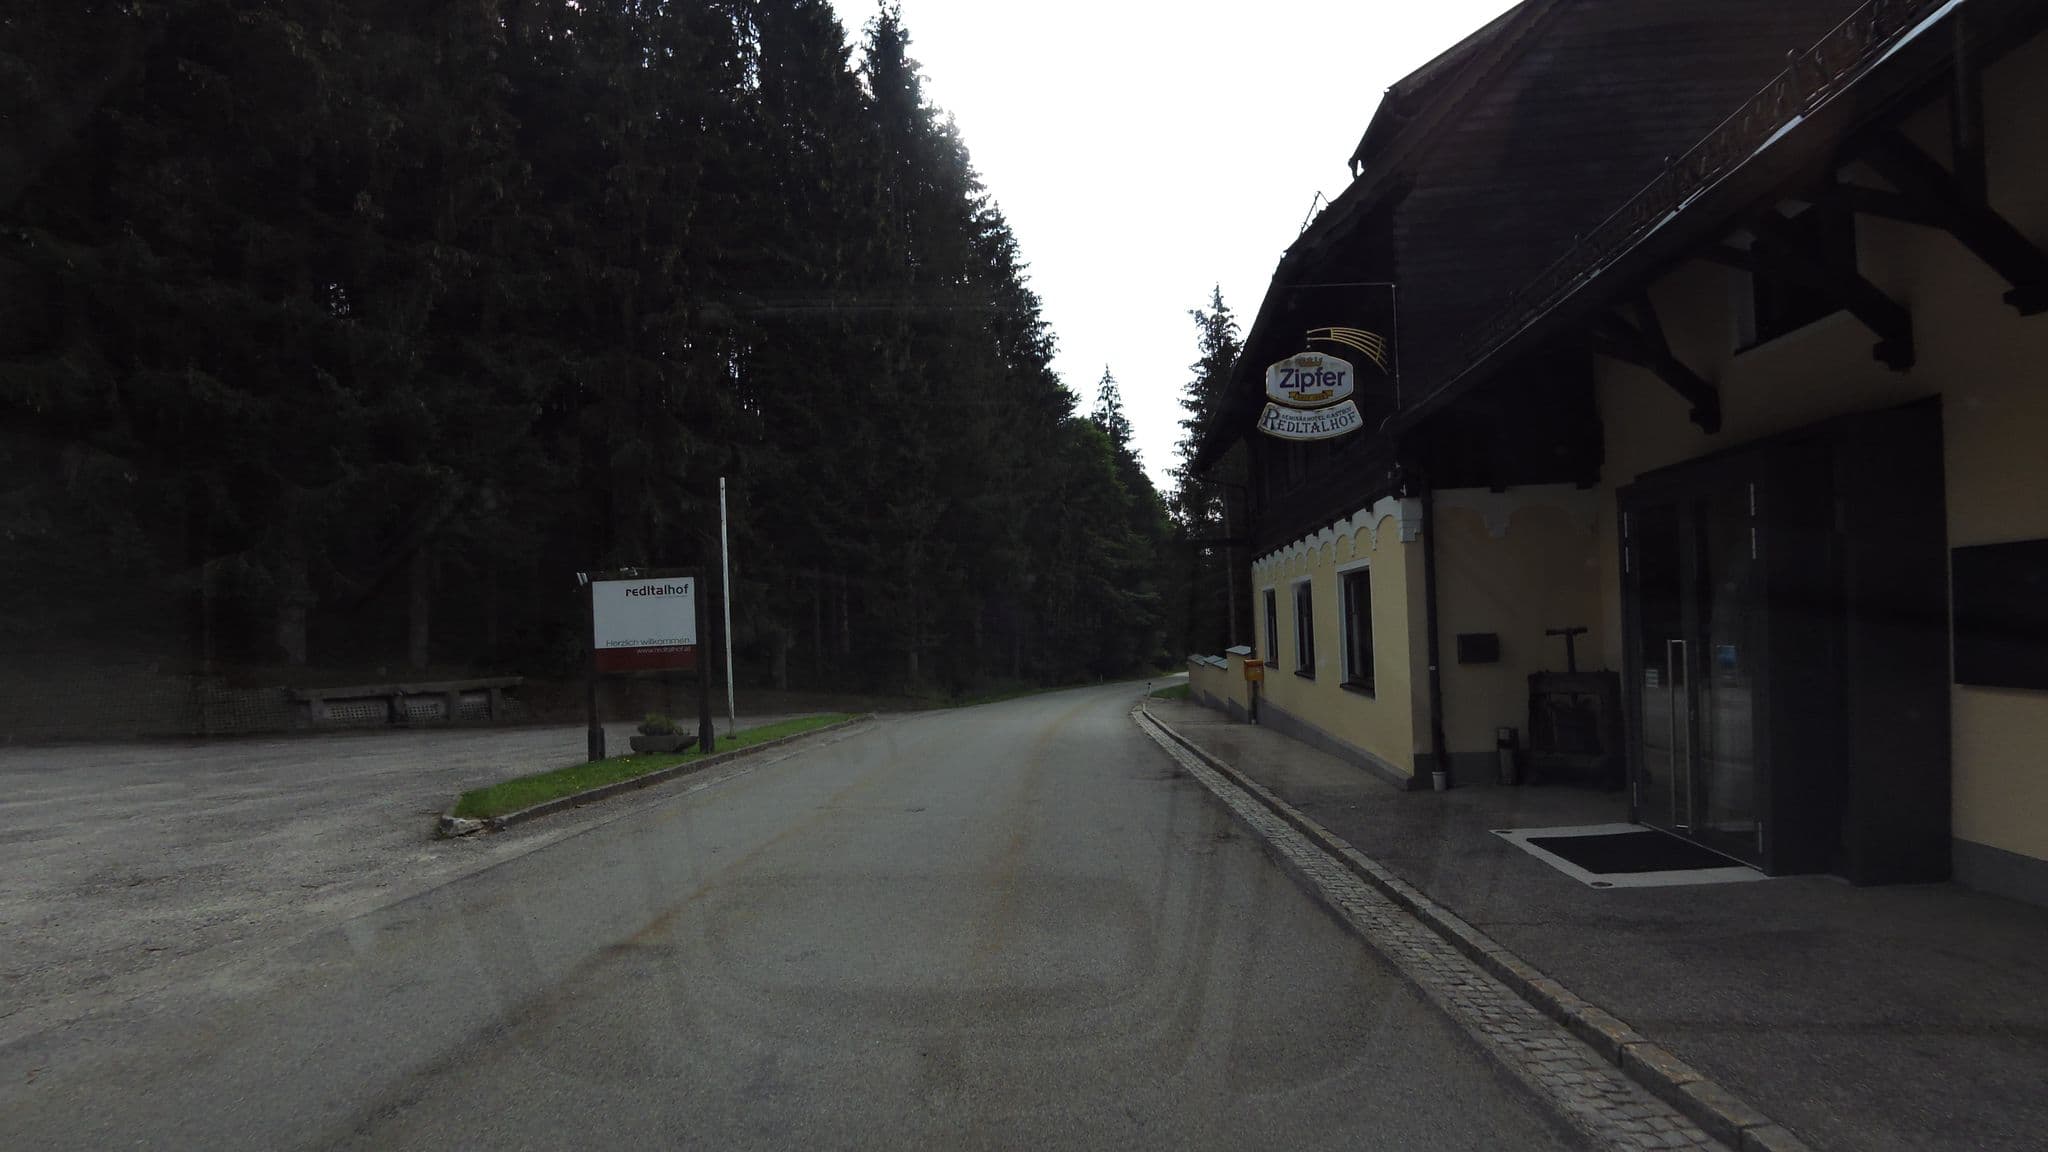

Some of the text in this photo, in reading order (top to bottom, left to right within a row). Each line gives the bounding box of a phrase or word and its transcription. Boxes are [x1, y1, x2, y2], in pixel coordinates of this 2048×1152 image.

[1279, 367, 1345, 392] Zipfer
[1263, 409, 1356, 433] REDLTALHOF
[626, 584, 689, 596] redltalhof
[606, 639, 639, 647] Herzlich
